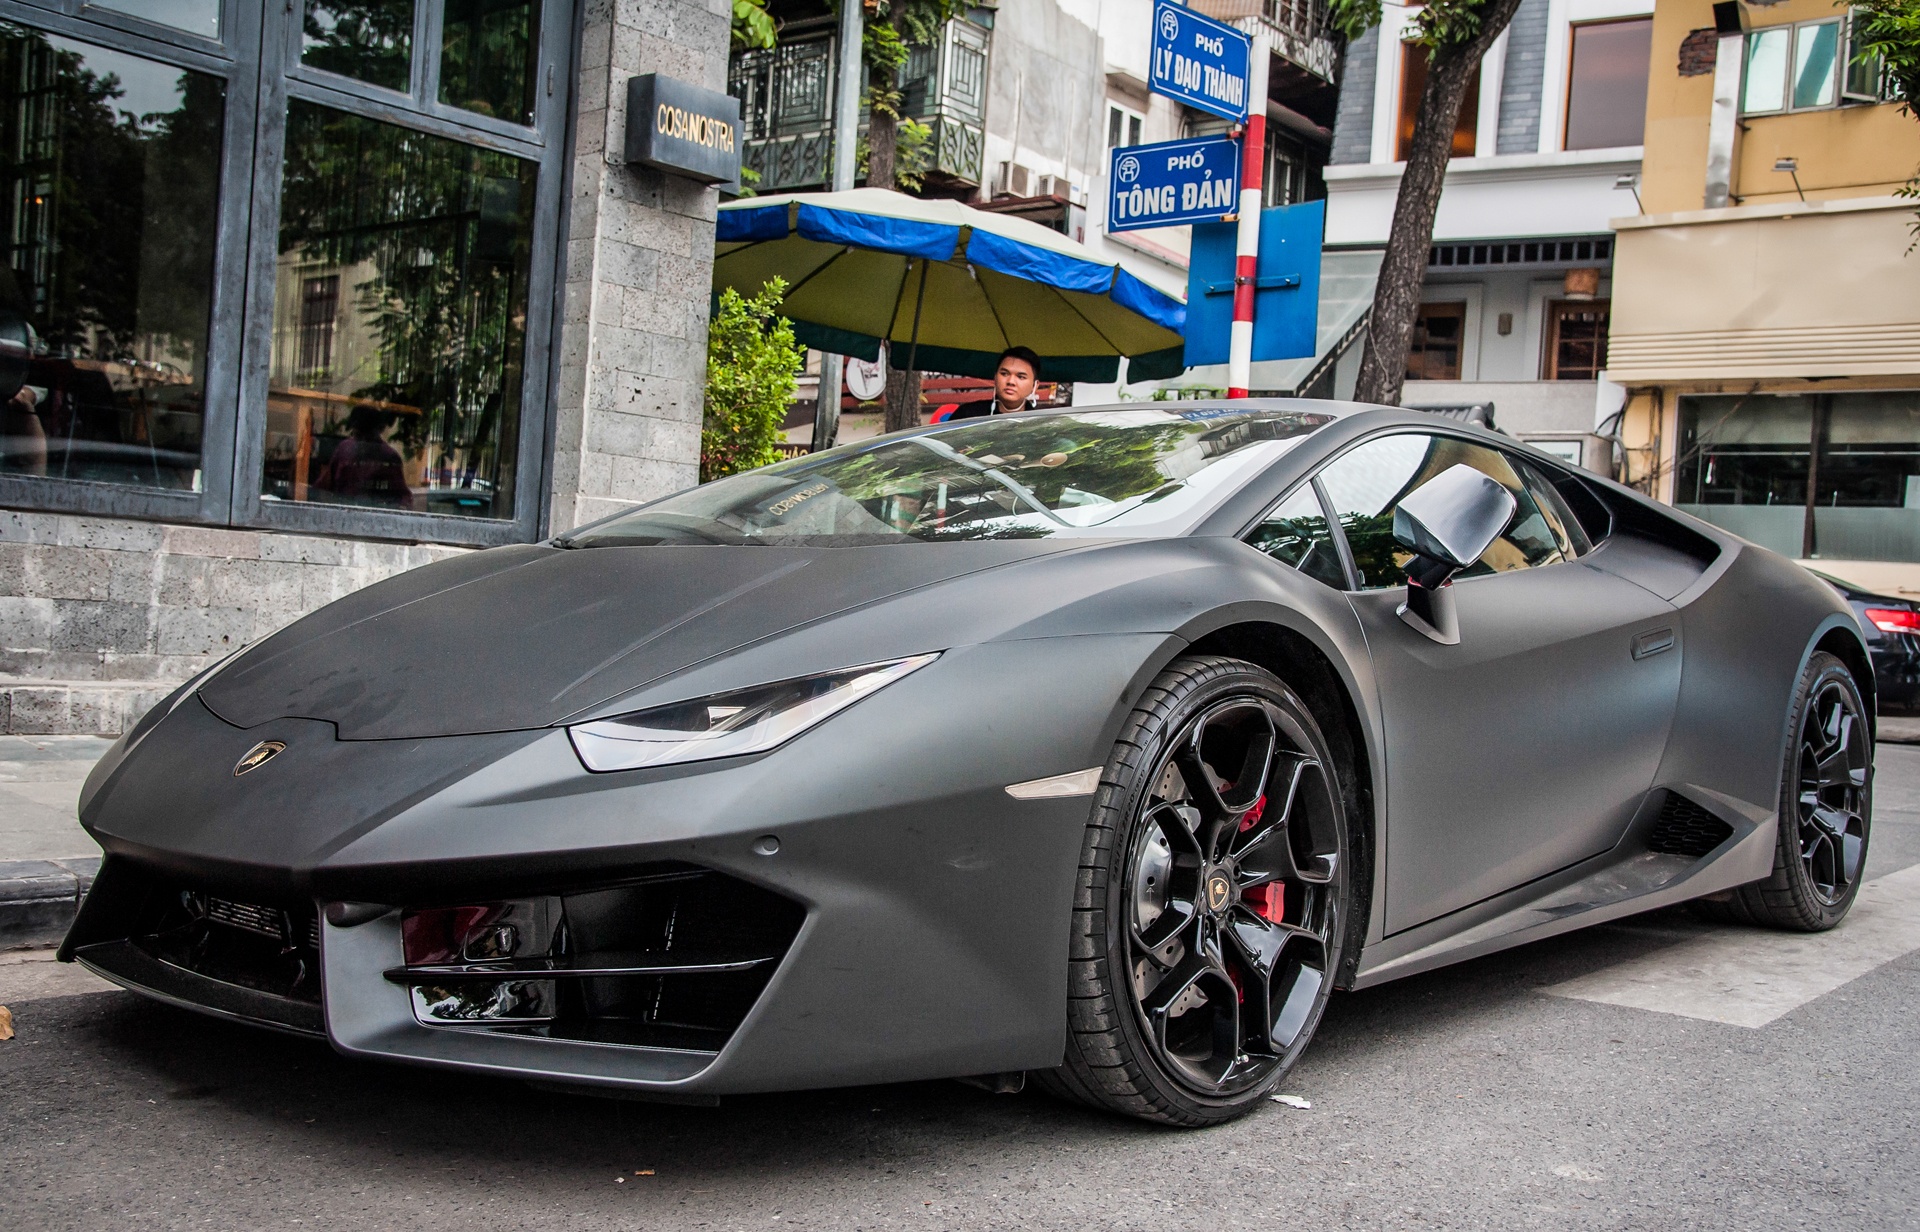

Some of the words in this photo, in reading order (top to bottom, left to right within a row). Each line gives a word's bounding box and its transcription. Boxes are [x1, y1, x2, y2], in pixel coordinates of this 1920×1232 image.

[1195, 33, 1224, 57] PHỐ
[1155, 44, 1172, 81] LÝ
[1174, 54, 1201, 94] ĐẠO
[1204, 65, 1244, 108] THÀNH
[657, 103, 735, 154] COSANOSTRA
[1167, 147, 1205, 171] PHỐ
[1117, 184, 1176, 219] TÔNG
[1182, 169, 1233, 211] ĐẢN
